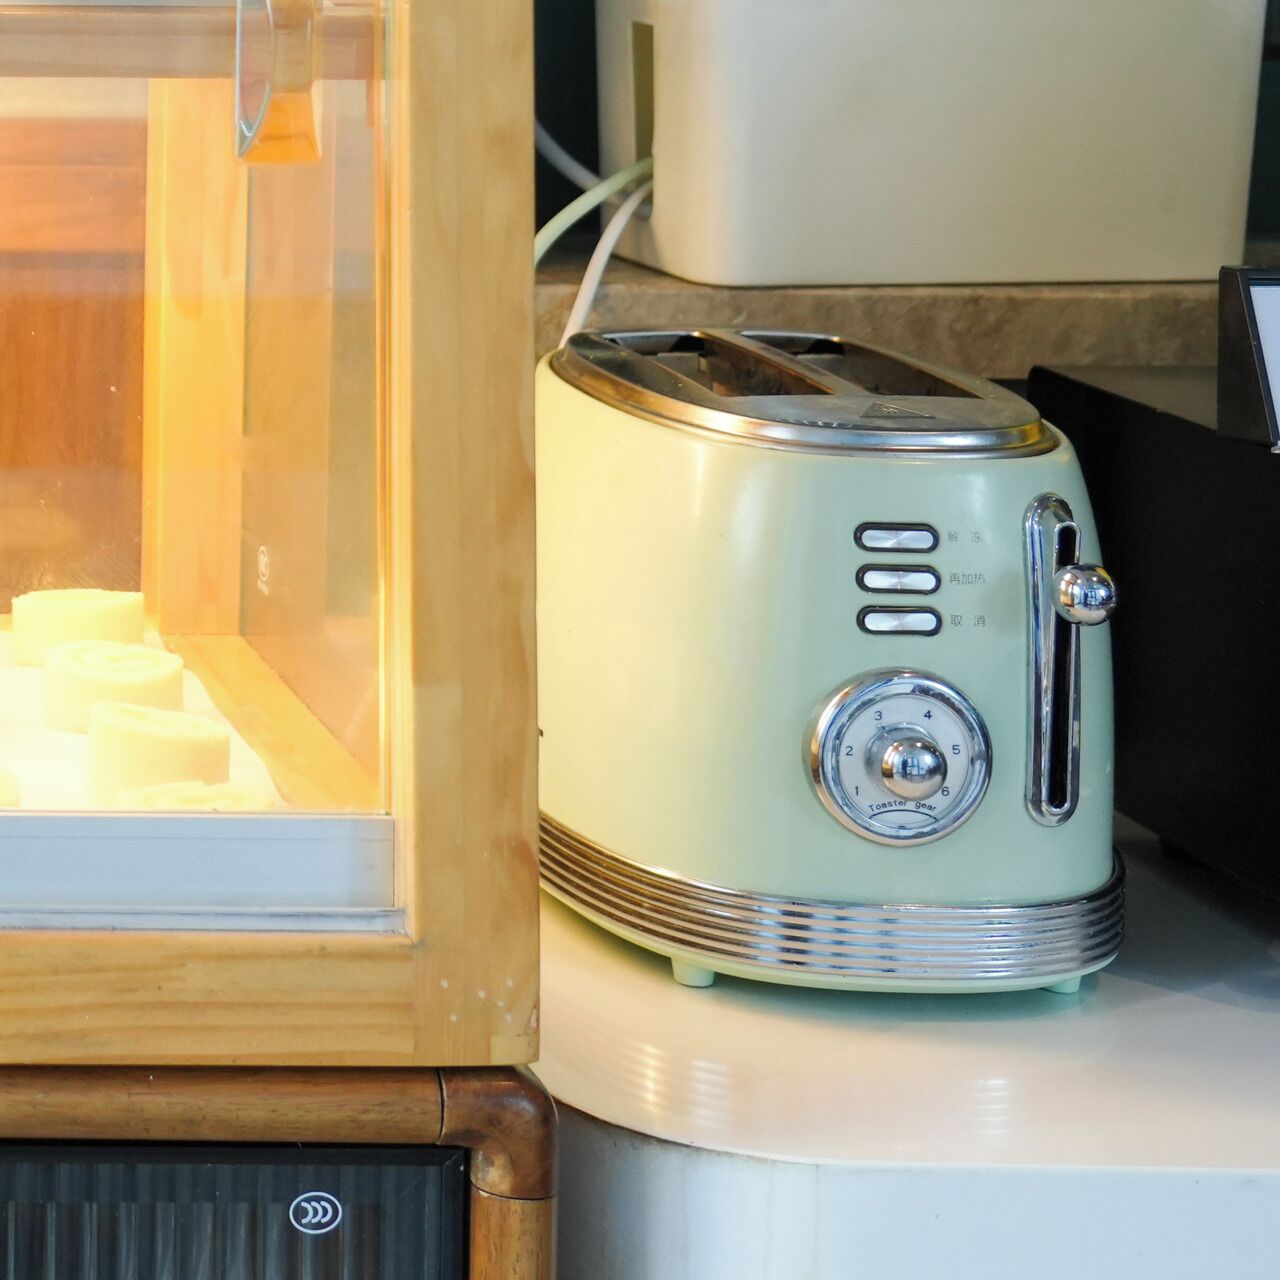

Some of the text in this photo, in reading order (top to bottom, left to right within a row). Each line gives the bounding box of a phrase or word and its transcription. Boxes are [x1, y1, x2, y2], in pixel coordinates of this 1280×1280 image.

[950, 572, 986, 586] 再加热
[950, 614, 986, 628] 取消
[874, 710, 883, 721] 3
[924, 710, 933, 720] 4
[845, 745, 854, 756] 2
[951, 744, 961, 755] 5
[854, 786, 860, 796] 1
[941, 786, 950, 797] 6
[868, 799, 937, 813] Toaster gear
